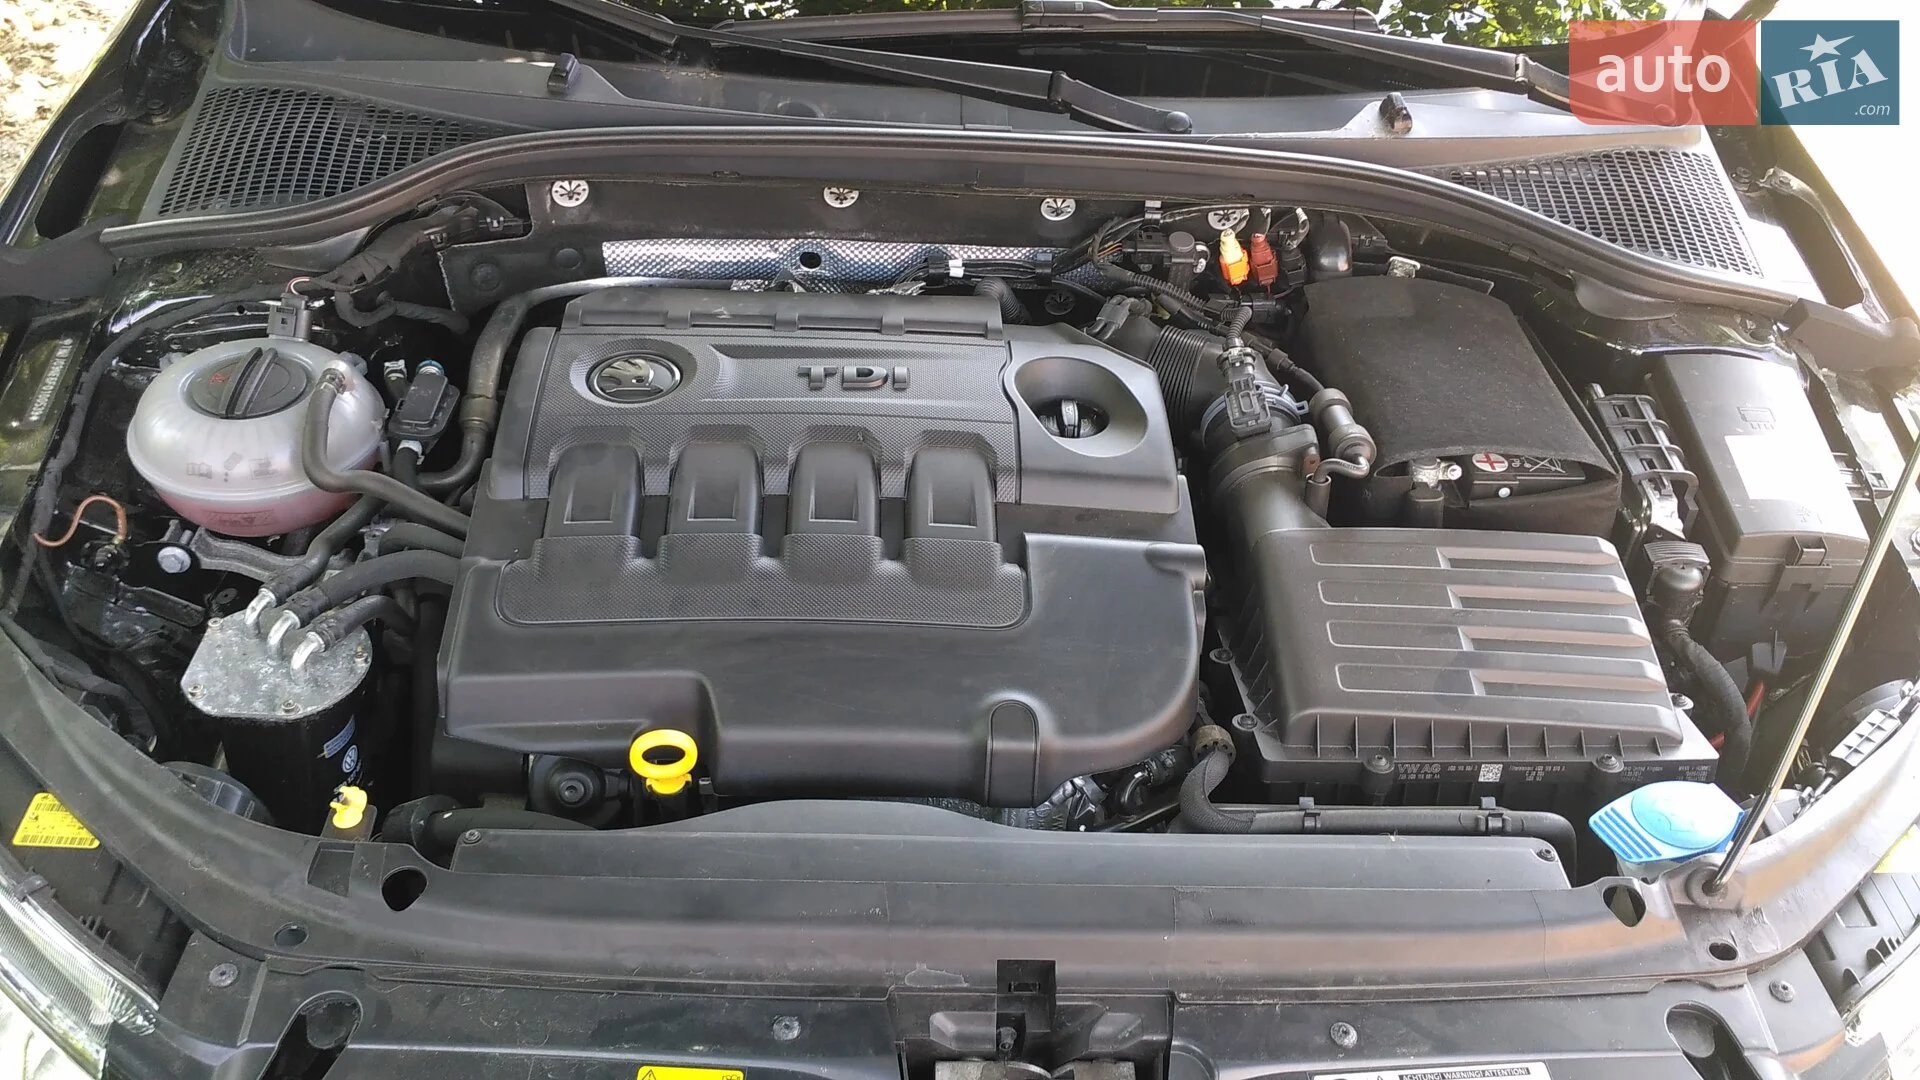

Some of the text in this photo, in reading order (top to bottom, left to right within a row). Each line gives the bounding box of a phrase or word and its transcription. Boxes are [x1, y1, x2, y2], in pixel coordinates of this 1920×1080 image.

[797, 364, 911, 390] TDI
[1397, 763, 1420, 774] VW
[1420, 763, 1441, 774] AG
[1444, 1070, 1483, 1080] WARNING!
[1484, 1067, 1528, 1077] ATTENTION!
